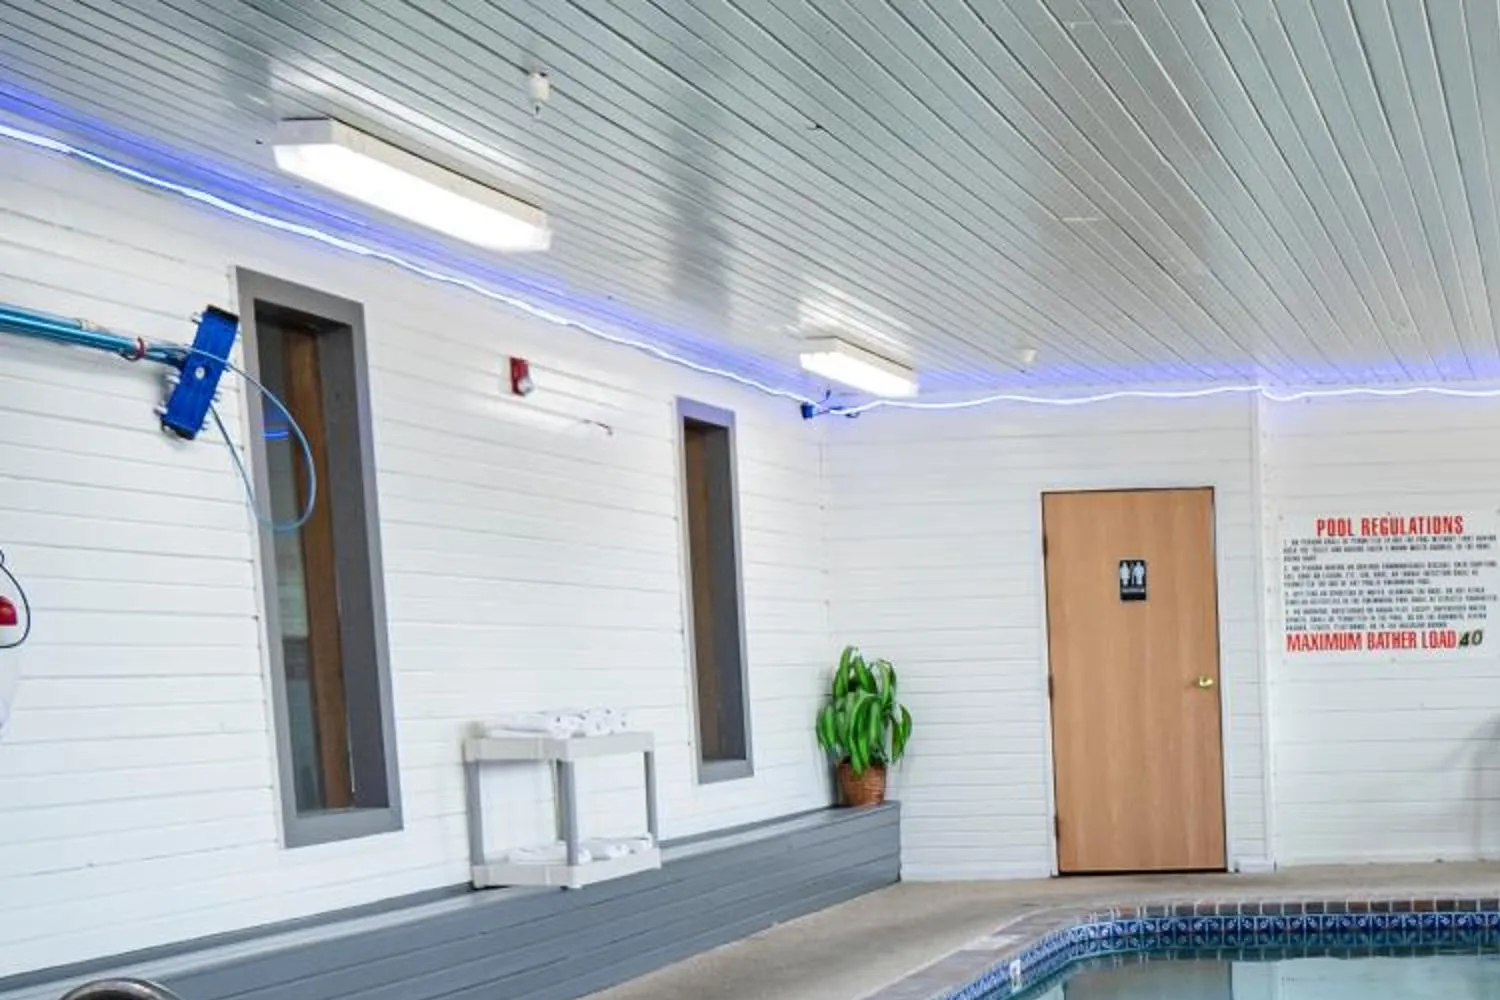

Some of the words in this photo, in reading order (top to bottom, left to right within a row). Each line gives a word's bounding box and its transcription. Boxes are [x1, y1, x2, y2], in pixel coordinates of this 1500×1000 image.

[1316, 519, 1354, 536] POOL
[1361, 516, 1464, 535] REGULATIONS
[1287, 632, 1361, 651] MAXIMUM
[1367, 631, 1417, 648] BATHER
[1421, 630, 1456, 648] LOAD
[1459, 630, 1483, 646] 40
